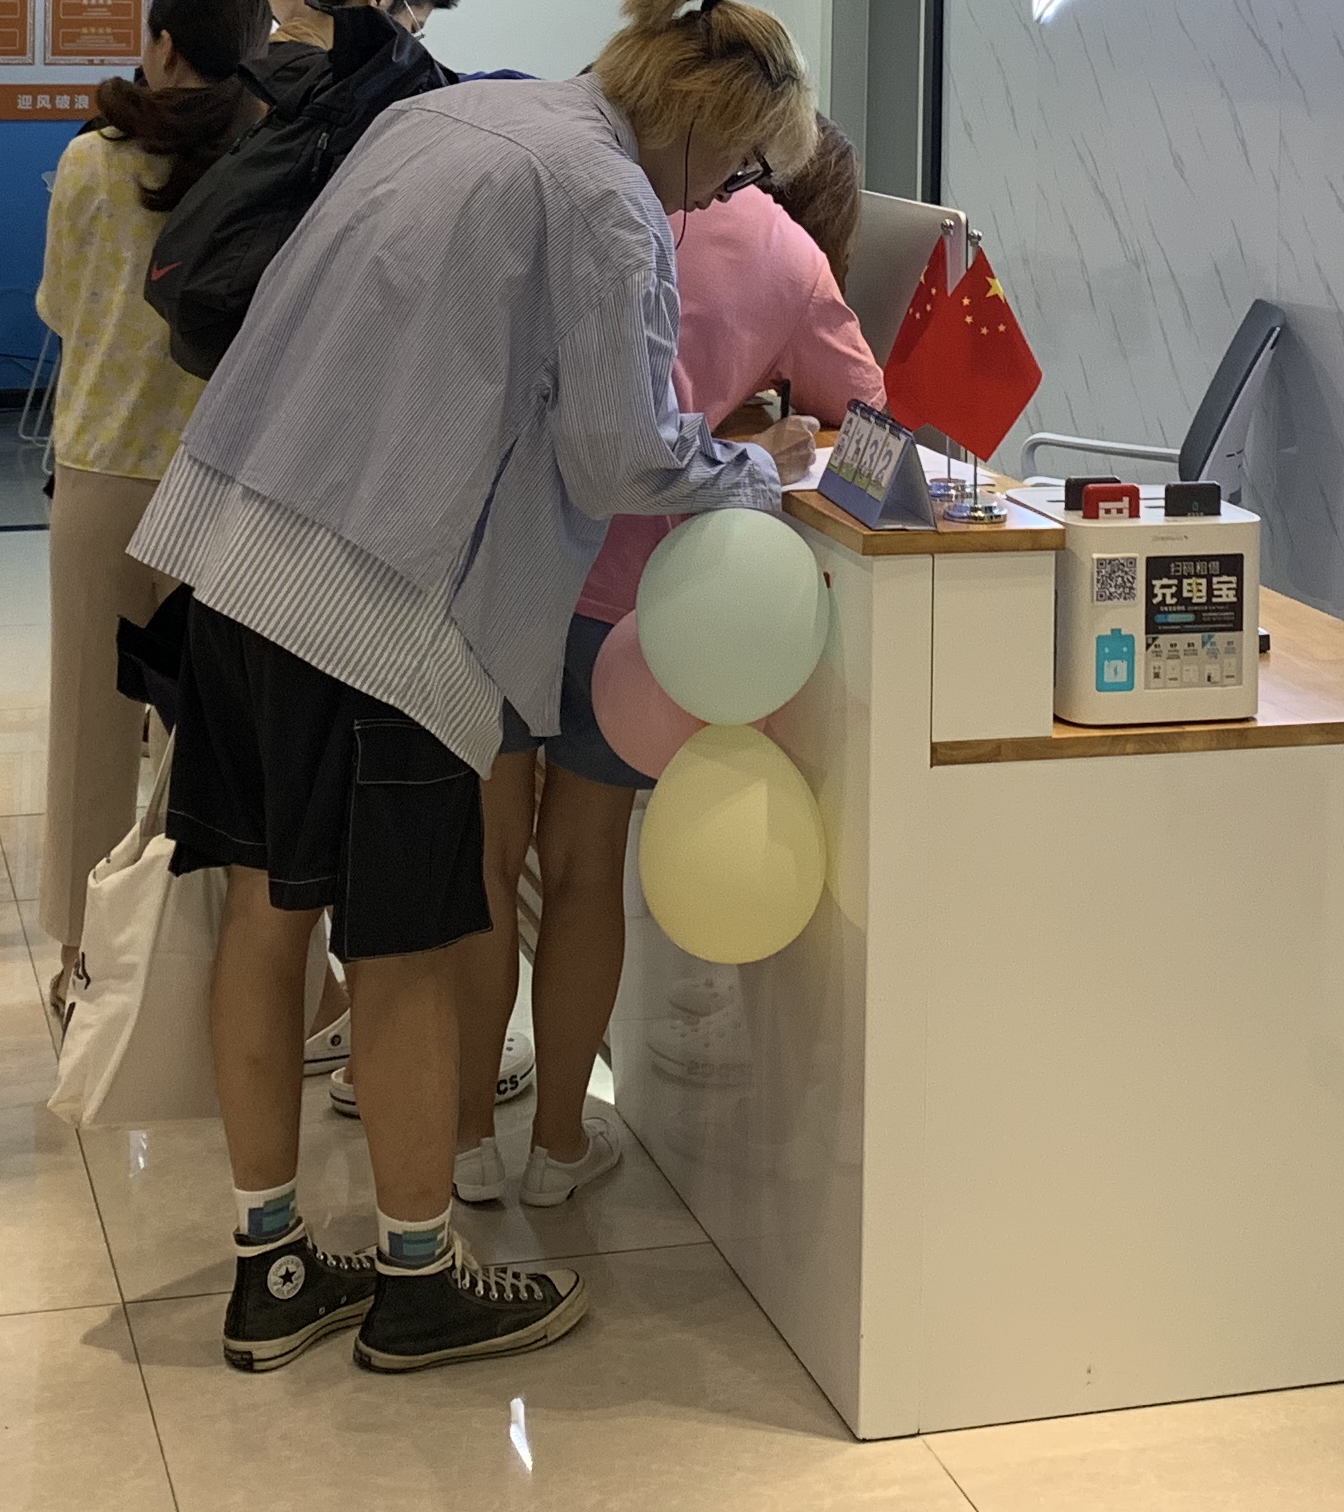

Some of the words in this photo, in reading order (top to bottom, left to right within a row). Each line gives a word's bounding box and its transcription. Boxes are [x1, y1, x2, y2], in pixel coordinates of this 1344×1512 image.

[17, 94, 90, 110] 迎风破浪
[1151, 575, 1237, 605] 充电宝
